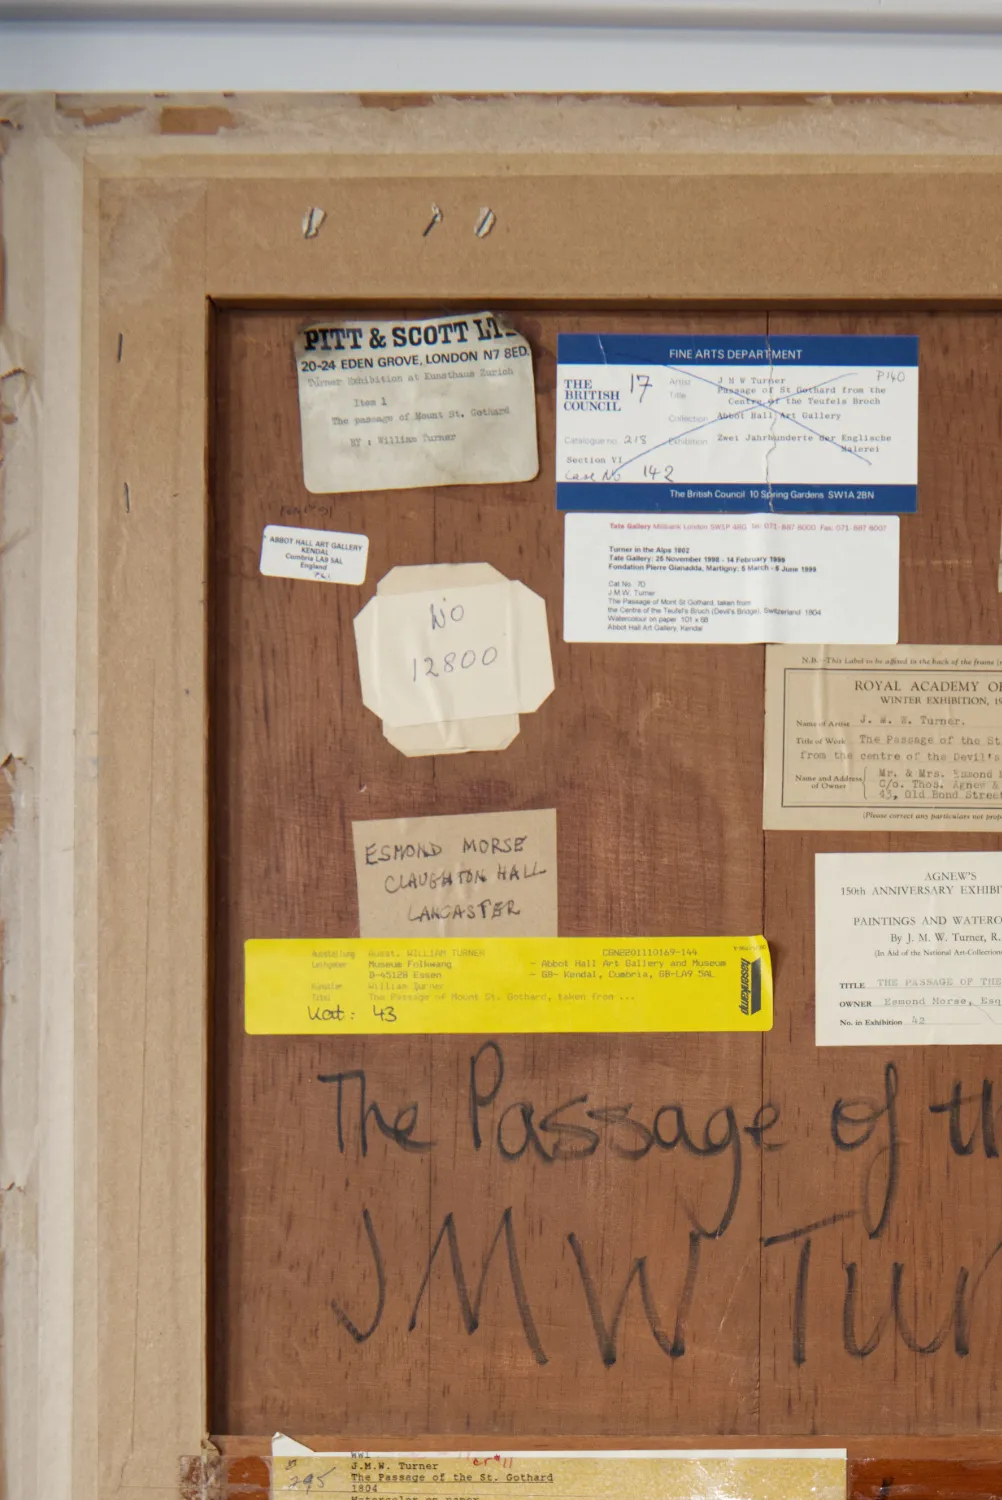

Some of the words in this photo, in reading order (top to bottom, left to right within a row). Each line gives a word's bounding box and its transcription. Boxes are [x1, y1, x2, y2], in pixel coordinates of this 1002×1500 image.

[304, 328, 363, 350] PITT
[369, 328, 386, 349] &
[392, 321, 469, 347] SCOTT
[301, 361, 336, 372] 20-24
[341, 359, 373, 369] EDEN
[378, 356, 423, 367] GROVE,
[426, 351, 478, 364] LONDON
[483, 349, 499, 360] N7
[669, 349, 693, 359] FINE
[695, 349, 725, 359] ARTS
[727, 349, 802, 359] DEPARTMENT
[564, 379, 592, 390] THE
[630, 374, 653, 403] 17
[565, 390, 620, 401] BRITISH
[564, 401, 621, 412] COUNCIL
[412, 647, 498, 682] 12800
[854, 680, 901, 692] ROYAL
[910, 681, 979, 692] ACADEMY
[365, 841, 443, 865] ESMOND
[462, 835, 528, 855] MORSE
[497, 861, 547, 881] HALL
[925, 871, 977, 881] AGNEW'S
[841, 886, 866, 896] 150th
[872, 885, 954, 895] ANNIVERSARY
[407, 899, 520, 922] LANCASTER
[853, 916, 916, 926] PAINTINGS
[922, 916, 947, 925] AND
[738, 958, 750, 1015] hasenkamp
[372, 1006, 397, 1022] 43
[314, 1068, 432, 1160] The
[465, 1040, 780, 1239] Passage
[830, 1059, 900, 1239] of
[399, 1462, 438, 1470] Turner
